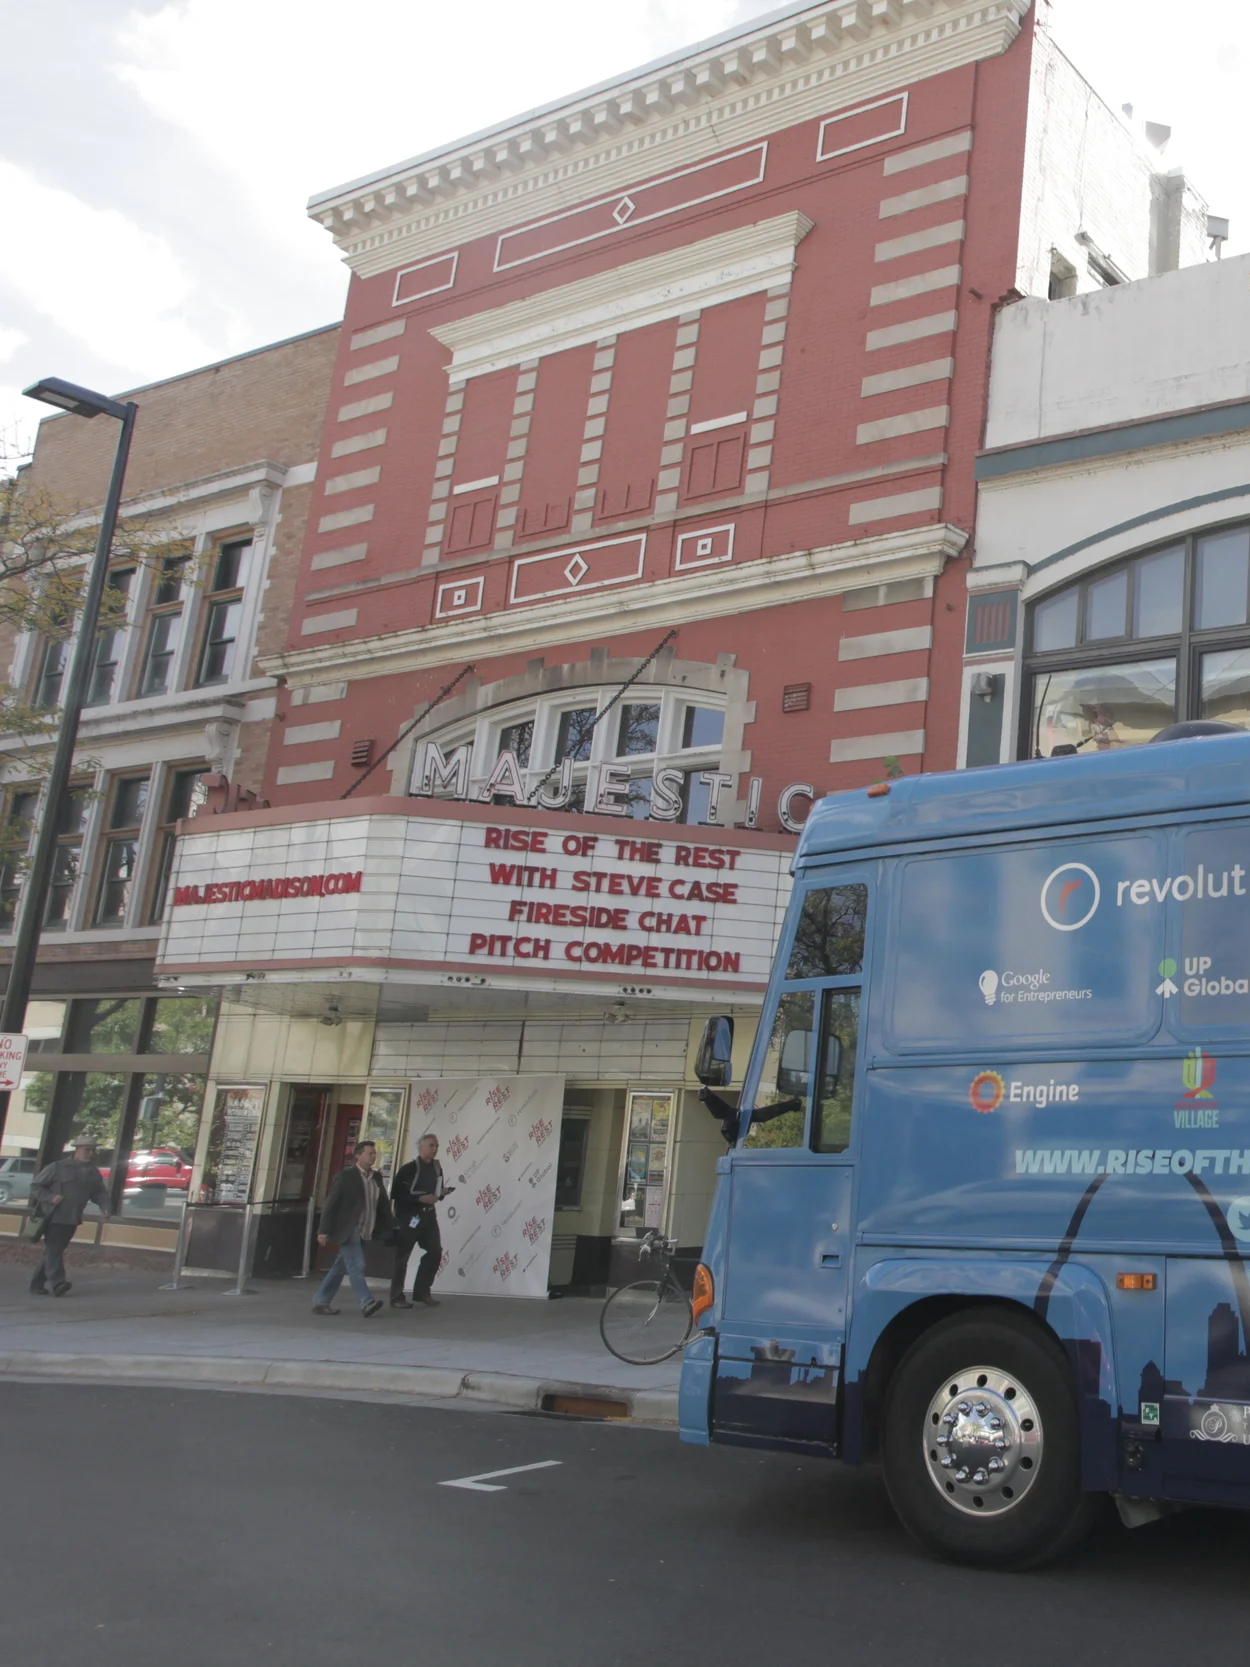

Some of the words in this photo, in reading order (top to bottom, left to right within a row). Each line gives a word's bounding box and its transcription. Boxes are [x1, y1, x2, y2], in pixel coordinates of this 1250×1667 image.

[409, 741, 814, 833] MAJESTIC
[484, 826, 548, 853] RISE
[562, 835, 598, 857] OF
[614, 838, 662, 863] THE
[675, 845, 741, 870] REST
[173, 871, 362, 907] MAJESTICMADISON.COM
[488, 862, 557, 889] WITH
[572, 870, 662, 898] STEVE
[668, 879, 738, 904] CASE
[508, 900, 630, 930] FIRESIDE
[638, 911, 707, 936] CHAT
[469, 933, 551, 960] PITCH
[564, 940, 740, 973] COMPETITION
[1184, 957, 1211, 976] UP
[1000, 992, 1016, 1003] for
[1017, 989, 1092, 1004] Entrepreneurs
[1001, 969, 1050, 990] Google
[1009, 1079, 1079, 1108] Engine
[1174, 1110, 1219, 1128] VILLAGE
